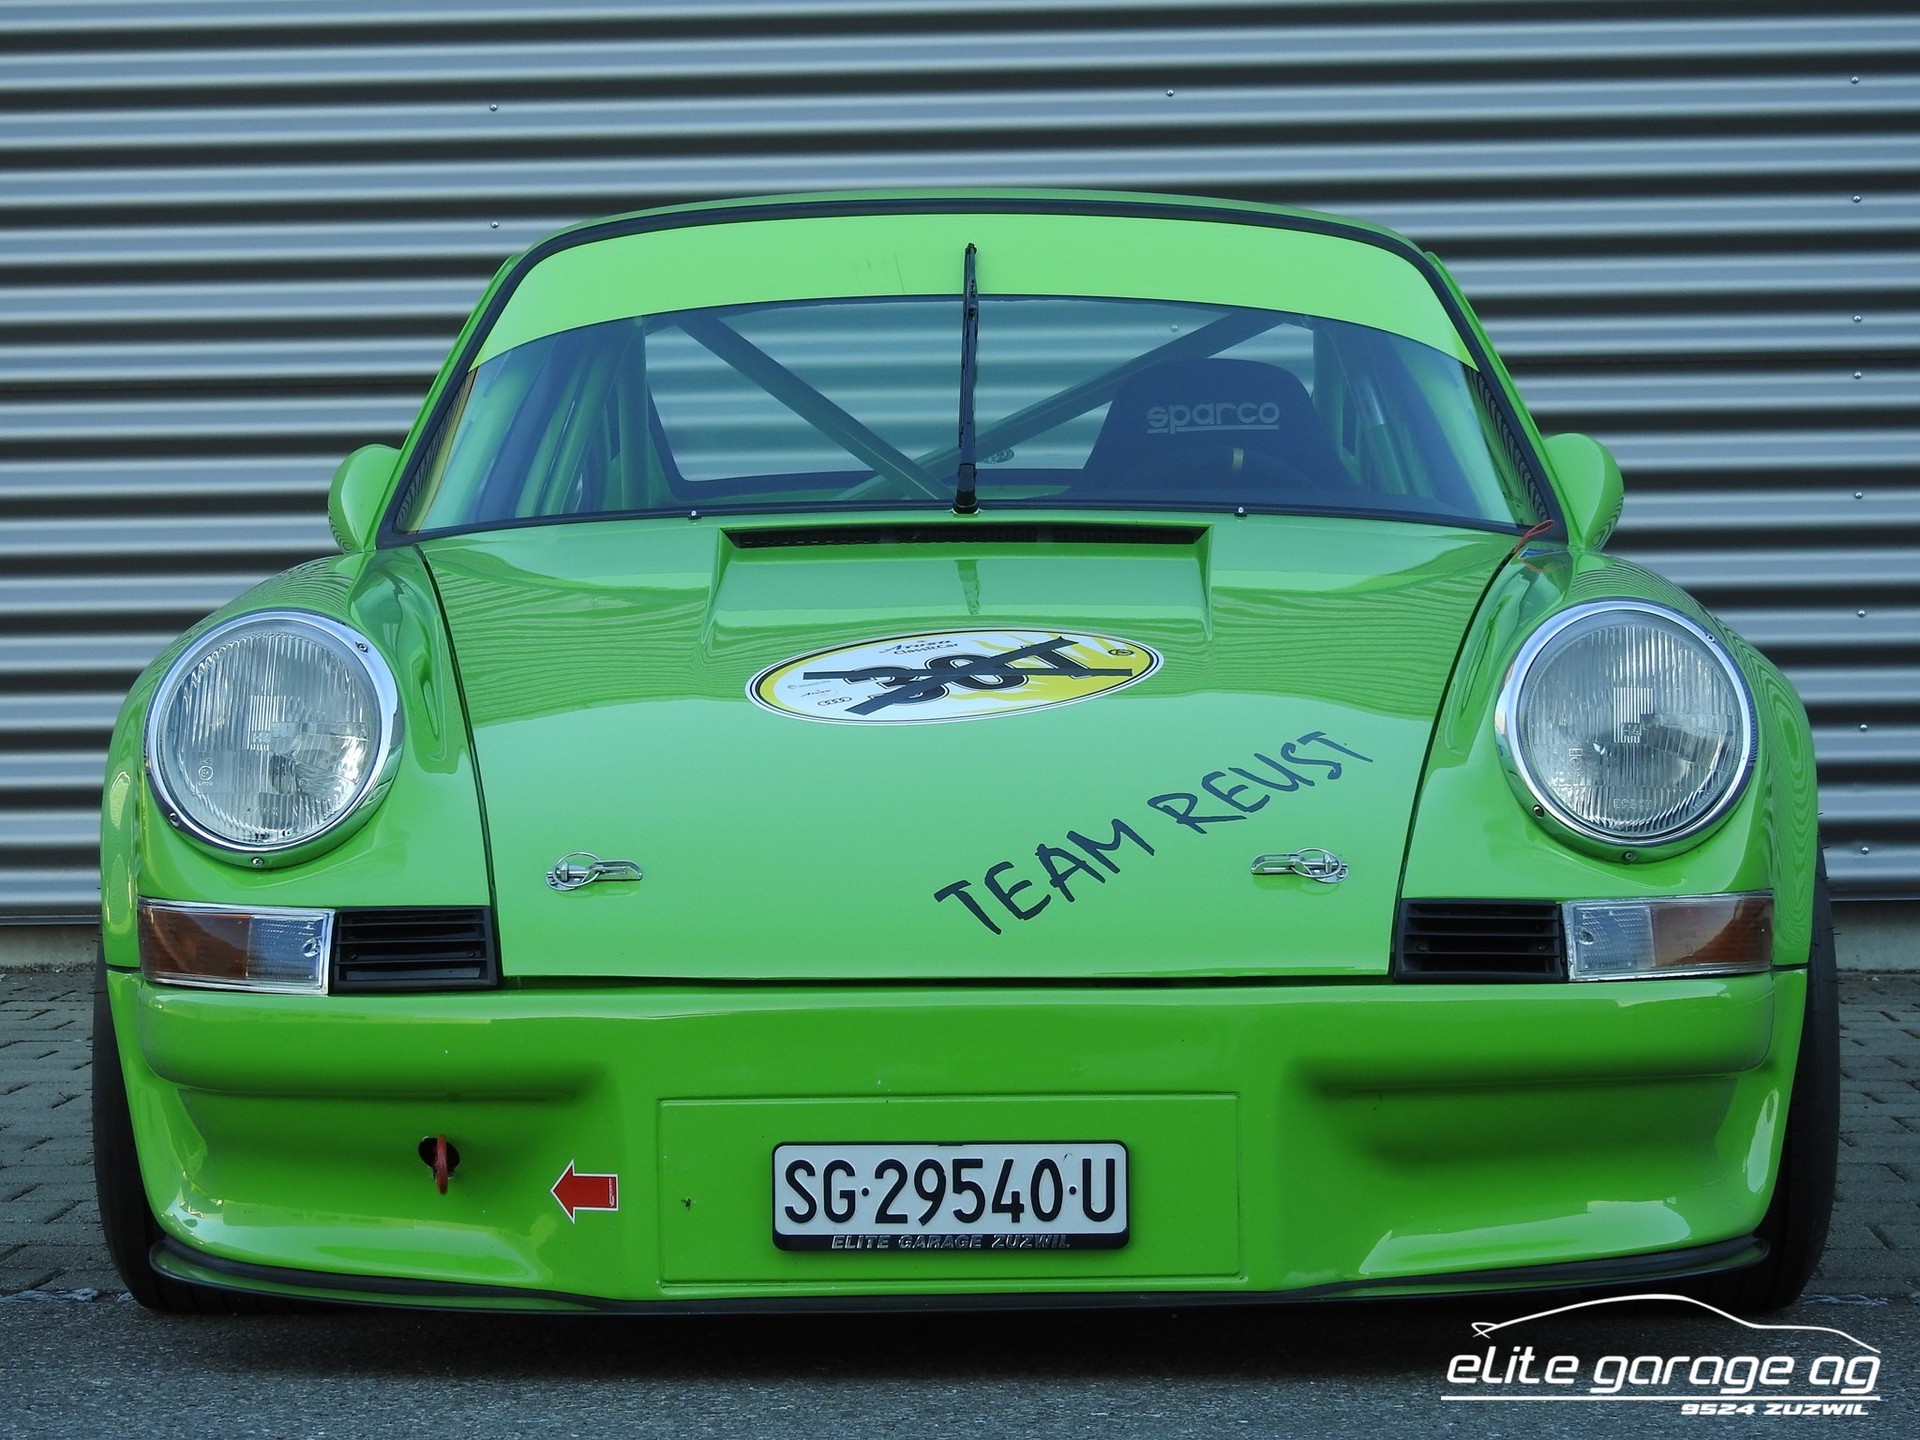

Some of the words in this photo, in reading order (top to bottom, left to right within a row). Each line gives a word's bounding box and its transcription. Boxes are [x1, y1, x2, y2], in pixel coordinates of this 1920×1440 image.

[1147, 402, 1280, 434] sparco
[933, 818, 1155, 935] TEAM
[1147, 731, 1374, 834] REUST
[831, 1235, 890, 1249] ELITE
[898, 1235, 983, 1249] GARAGE
[991, 1234, 1071, 1248] ZUZWIL
